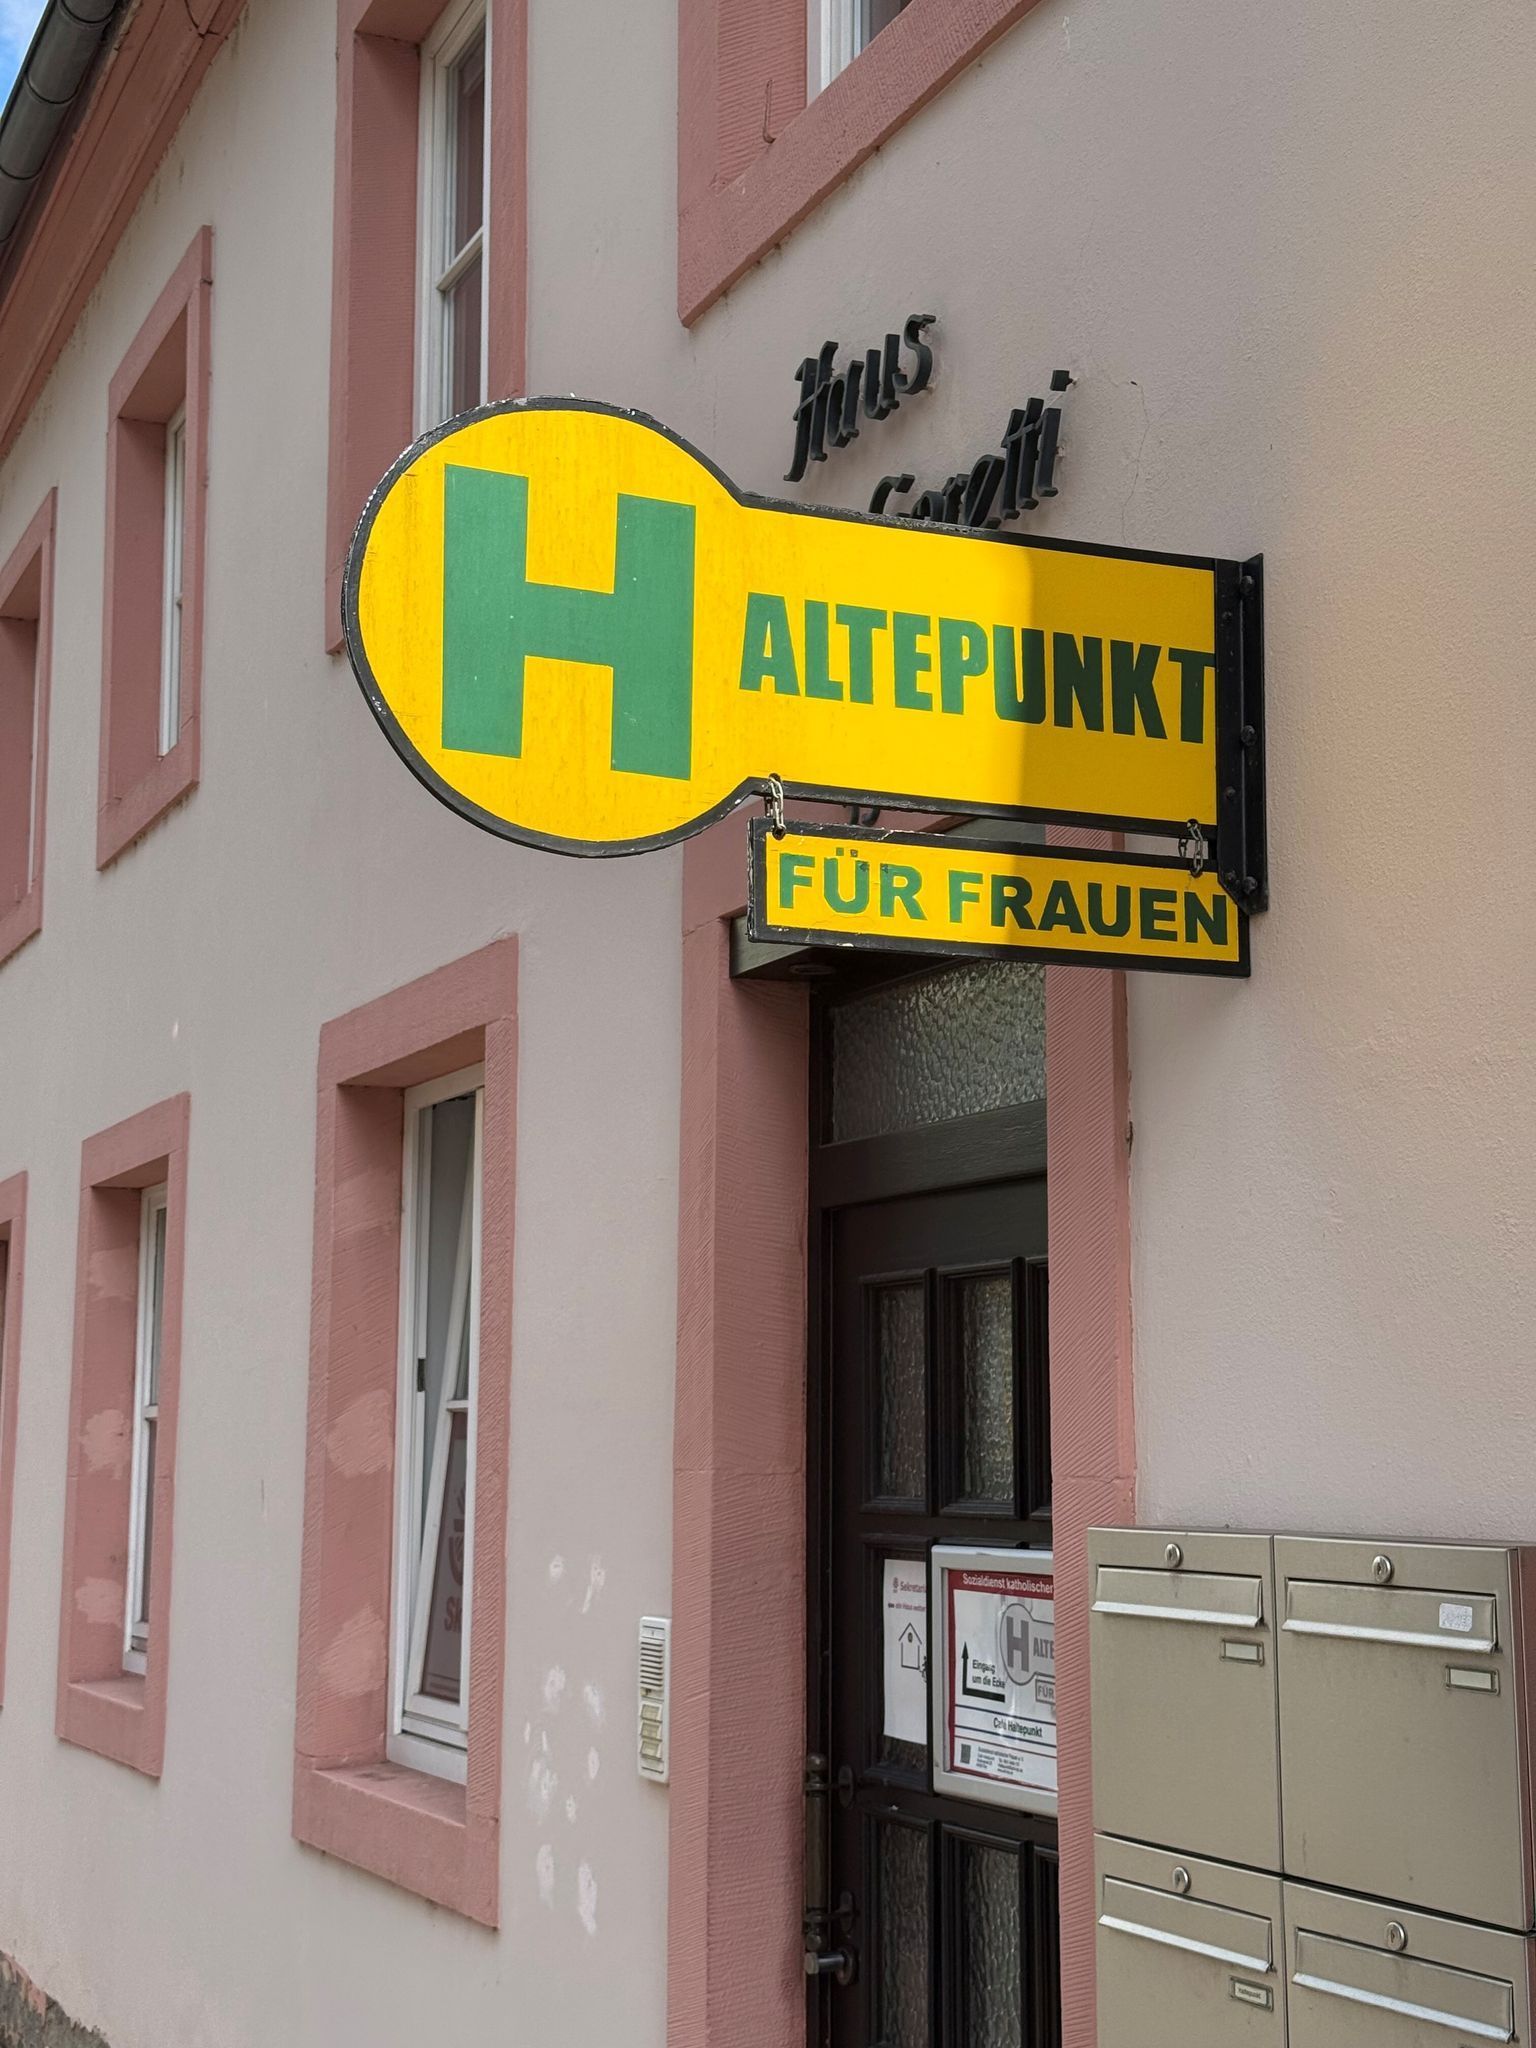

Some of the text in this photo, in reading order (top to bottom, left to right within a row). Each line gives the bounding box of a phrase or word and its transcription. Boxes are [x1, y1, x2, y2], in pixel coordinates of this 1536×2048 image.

[783, 314, 936, 481] Haus
[777, 847, 1227, 946] FÜR FRAUEN
[962, 1573, 1054, 1594] Sozialdienst katholischer
[1007, 1720, 1043, 1738] Haltepunkt
